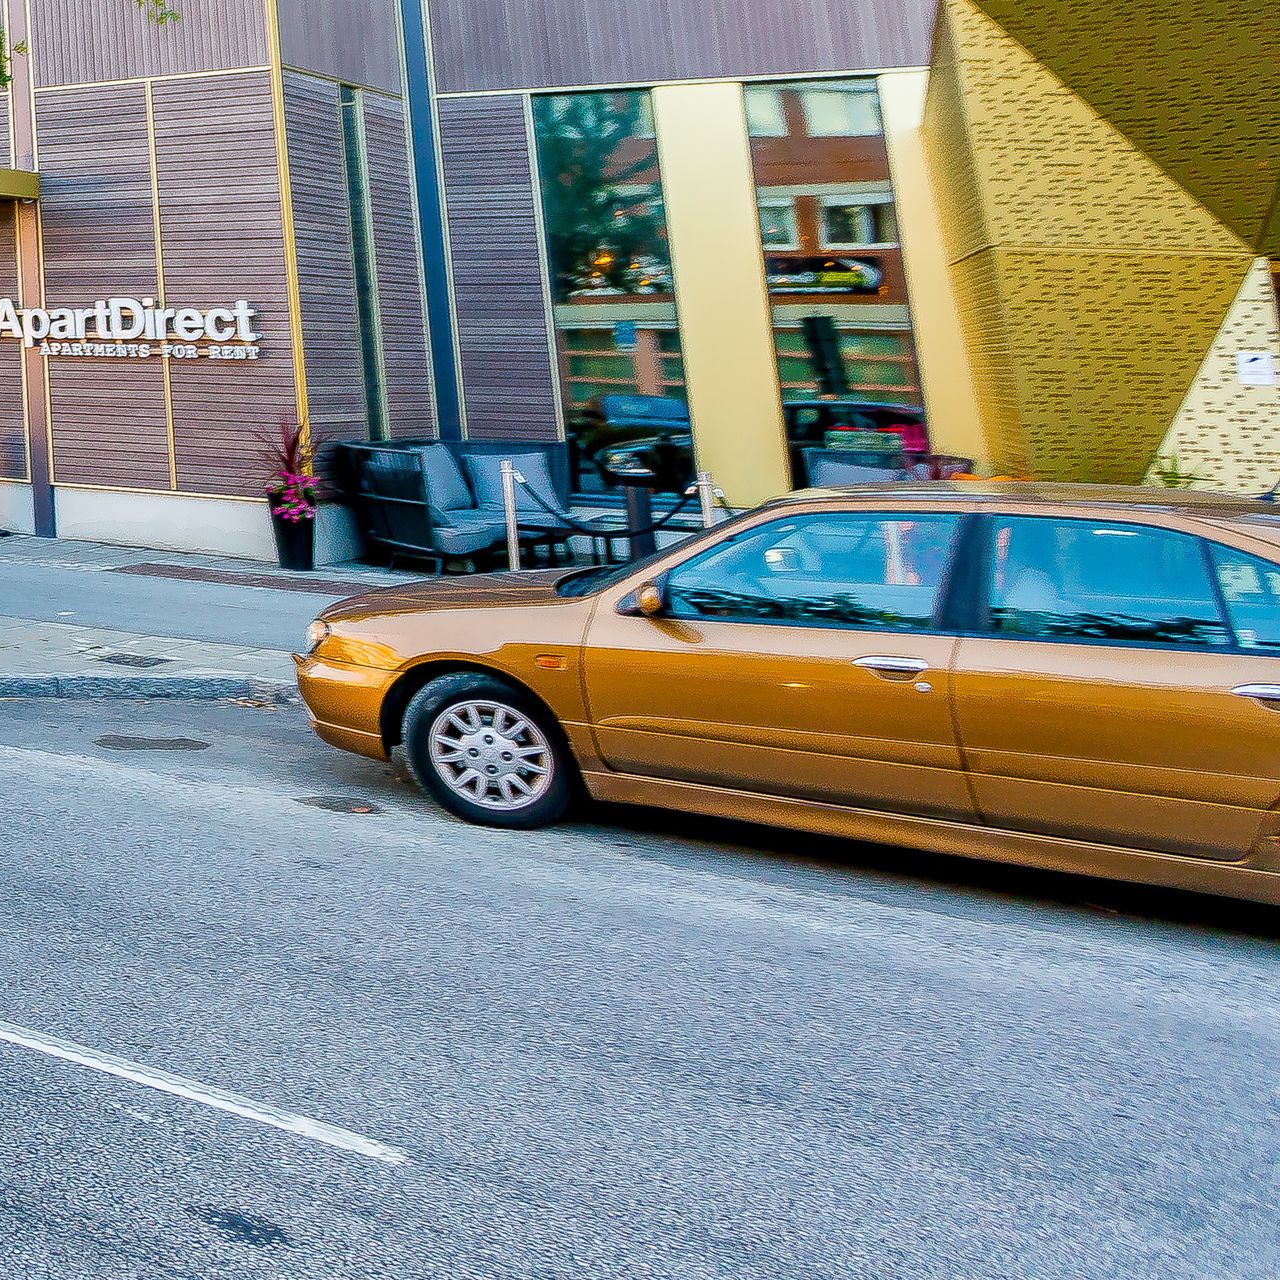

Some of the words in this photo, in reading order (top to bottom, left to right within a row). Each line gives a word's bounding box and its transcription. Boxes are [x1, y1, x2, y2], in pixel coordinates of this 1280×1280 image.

[40, 342, 150, 359] APARTMENTS
[162, 344, 198, 360] FOR
[208, 345, 260, 361] RENT
